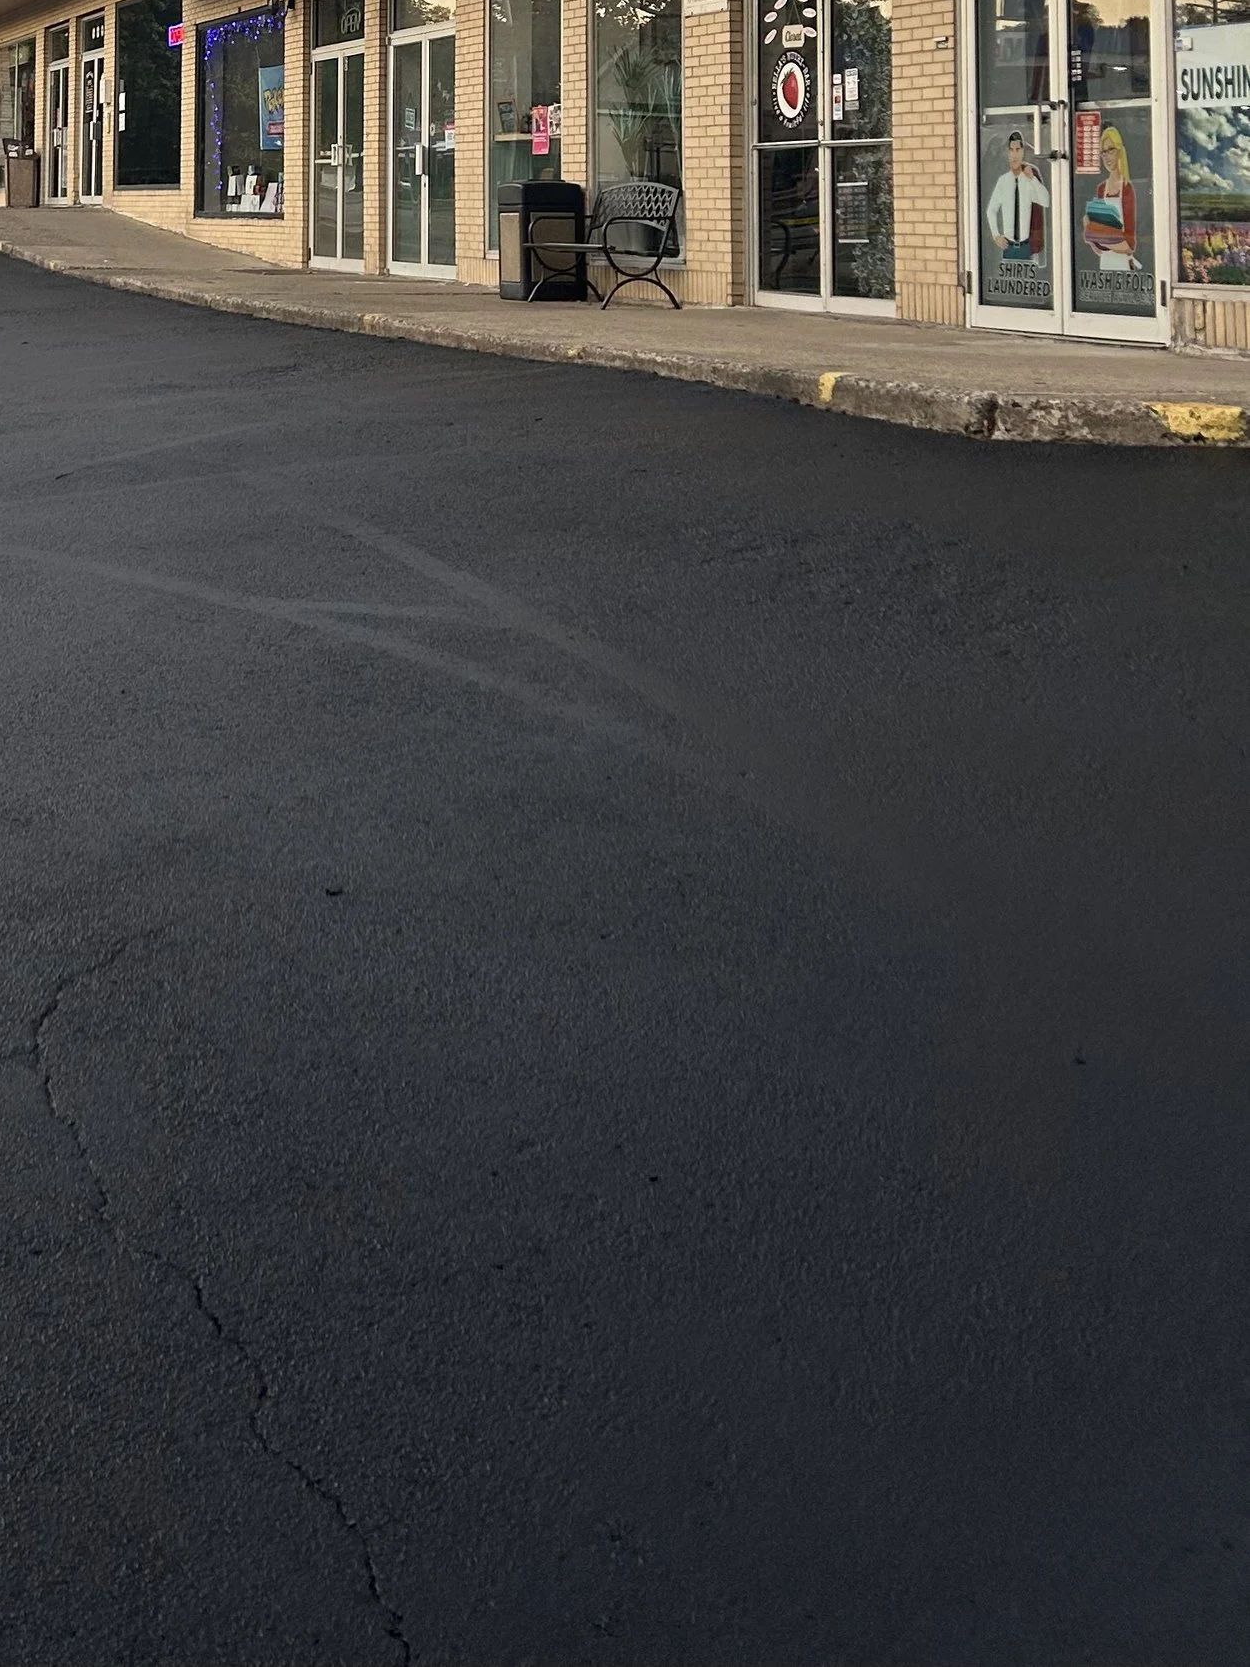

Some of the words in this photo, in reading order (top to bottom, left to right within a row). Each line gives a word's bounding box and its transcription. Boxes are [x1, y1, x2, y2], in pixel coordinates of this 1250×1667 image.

[999, 262, 1036, 279] SHIRTS
[987, 278, 1050, 297] LAUNDERED
[1079, 271, 1112, 291] WASH
[1126, 272, 1154, 292] FOLD
